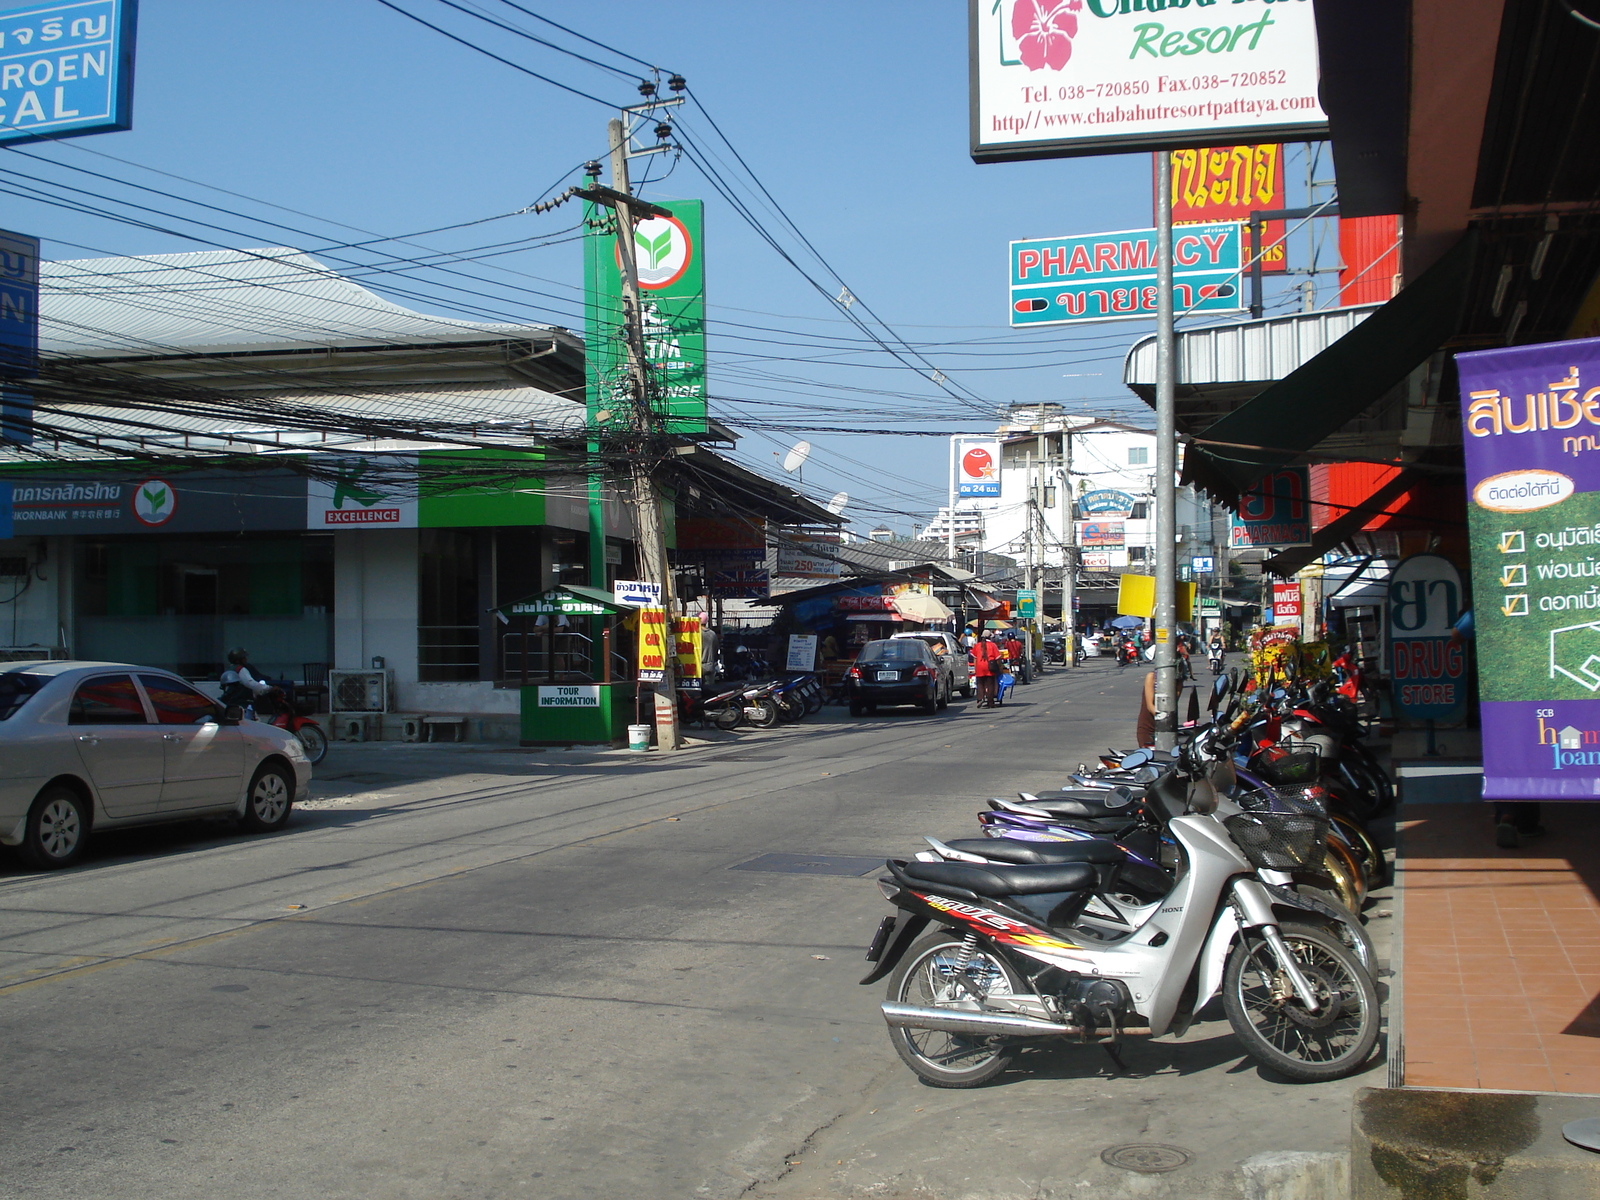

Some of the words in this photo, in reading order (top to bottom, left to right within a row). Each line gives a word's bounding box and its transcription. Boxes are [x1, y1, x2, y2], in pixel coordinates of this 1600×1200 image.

[0, 15, 106, 49] จริญ
[1129, 9, 1275, 60] Resort
[1021, 85, 1052, 104] Tel.
[1058, 81, 1150, 101] 038-720850
[972, 484, 985, 493] 24
[12, 510, 68, 520] IKORNBANK
[328, 511, 398, 522] EXCELLENCE
[1232, 522, 1308, 545] PHARMACY
[794, 559, 813, 571] 250
[1391, 578, 1458, 631] ยา
[642, 611, 665, 624] CLEAN
[645, 633, 660, 646] CAR
[1393, 640, 1463, 679] DRUG
[557, 687, 579, 695] TOUR
[1401, 684, 1455, 705] STORE
[541, 697, 597, 705] INFORMATION
[1536, 708, 1554, 718] SCB
